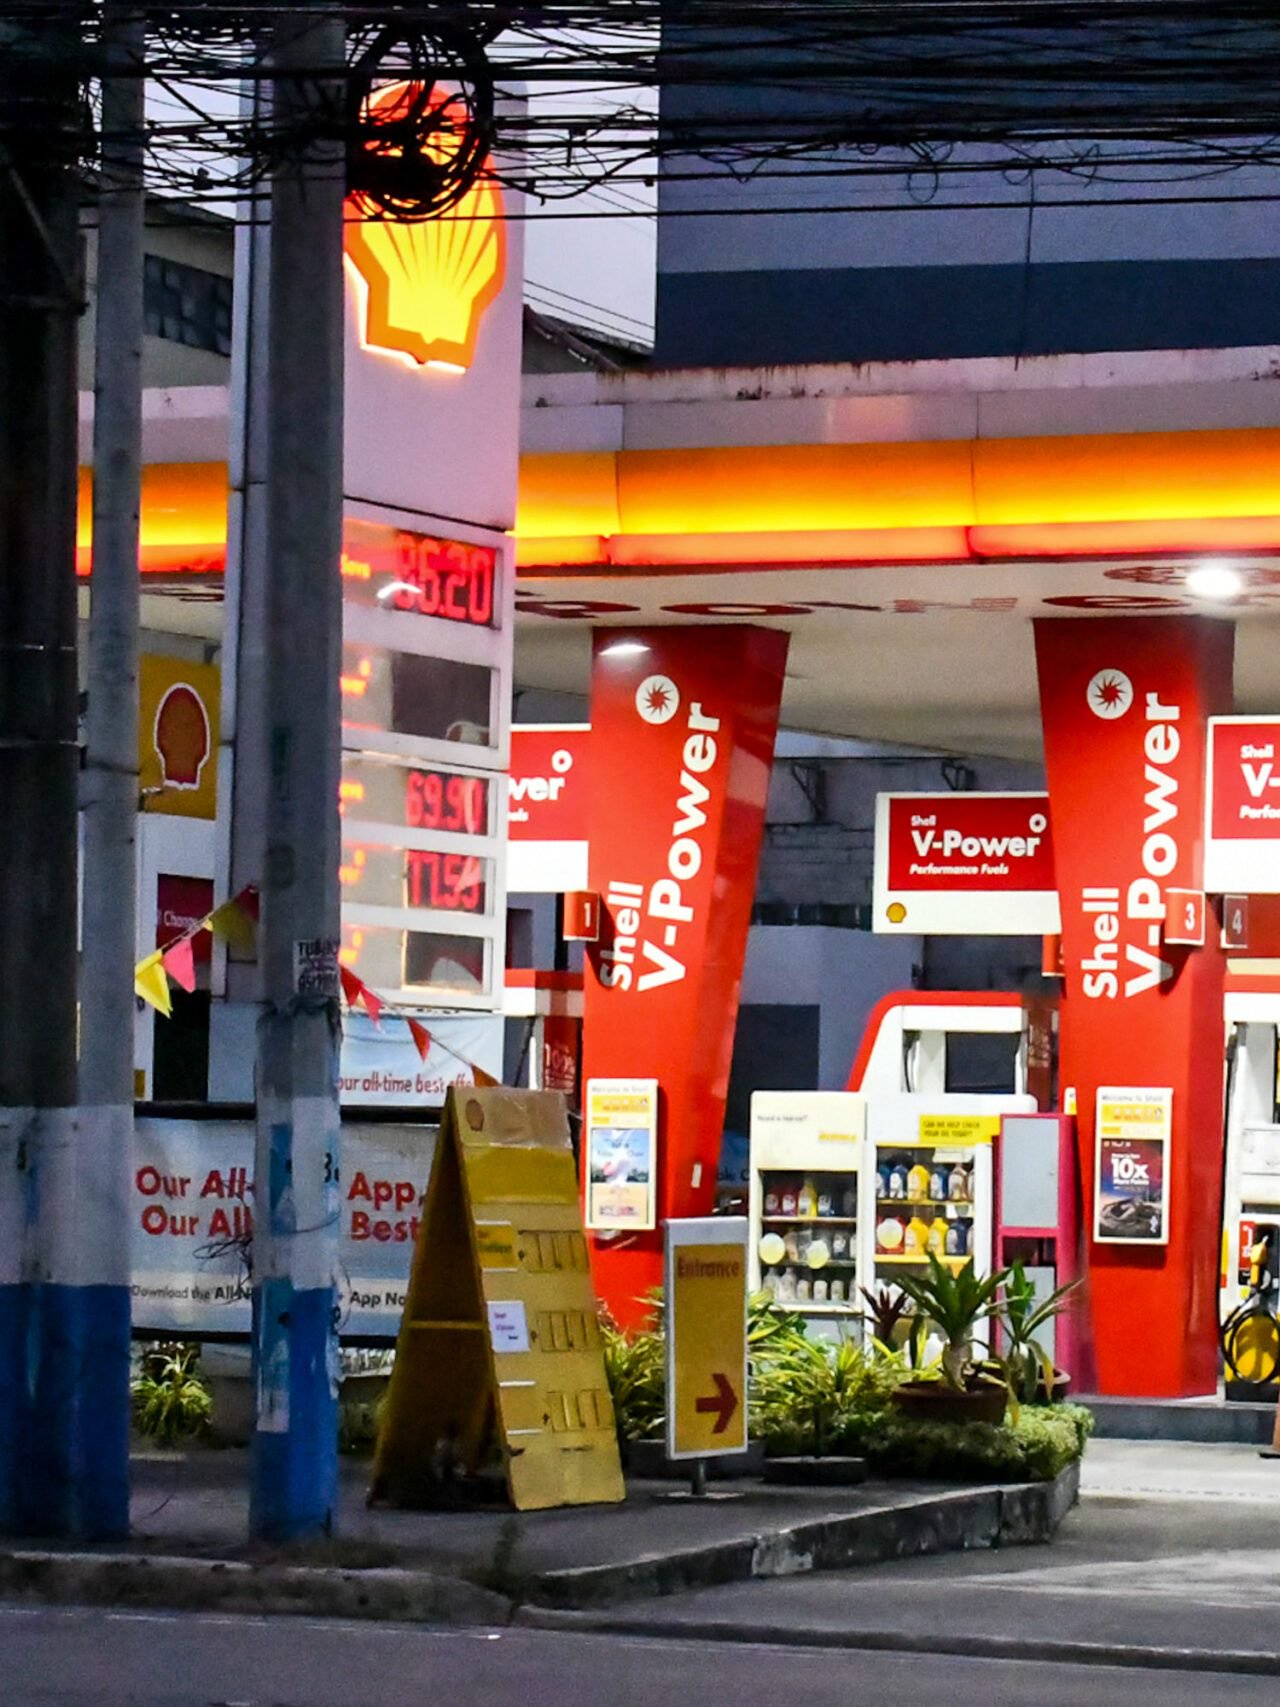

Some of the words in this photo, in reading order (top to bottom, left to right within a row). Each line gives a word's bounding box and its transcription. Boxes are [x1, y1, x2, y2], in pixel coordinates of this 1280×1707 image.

[1240, 744, 1274, 758] Shell
[911, 815, 937, 827] Shell
[637, 702, 720, 991] V-Power
[911, 829, 1041, 858] V-Power
[1125, 692, 1180, 998] V-Power
[909, 863, 979, 875] Performance
[981, 863, 1009, 875] Fuels
[1184, 902, 1196, 931] 3
[1232, 909, 1243, 934] 4
[600, 881, 643, 992] Shell
[1081, 888, 1119, 999] Shell
[416, 1073, 445, 1093] best
[136, 1165, 191, 1198] Our
[1111, 1157, 1149, 1180] 10x
[142, 1204, 199, 1237] Our
[351, 1211, 422, 1243] Best
[677, 1255, 740, 1279] Entrance
[191, 1286, 210, 1300] the
[350, 1291, 381, 1308] App
[385, 1292, 405, 1305] No
